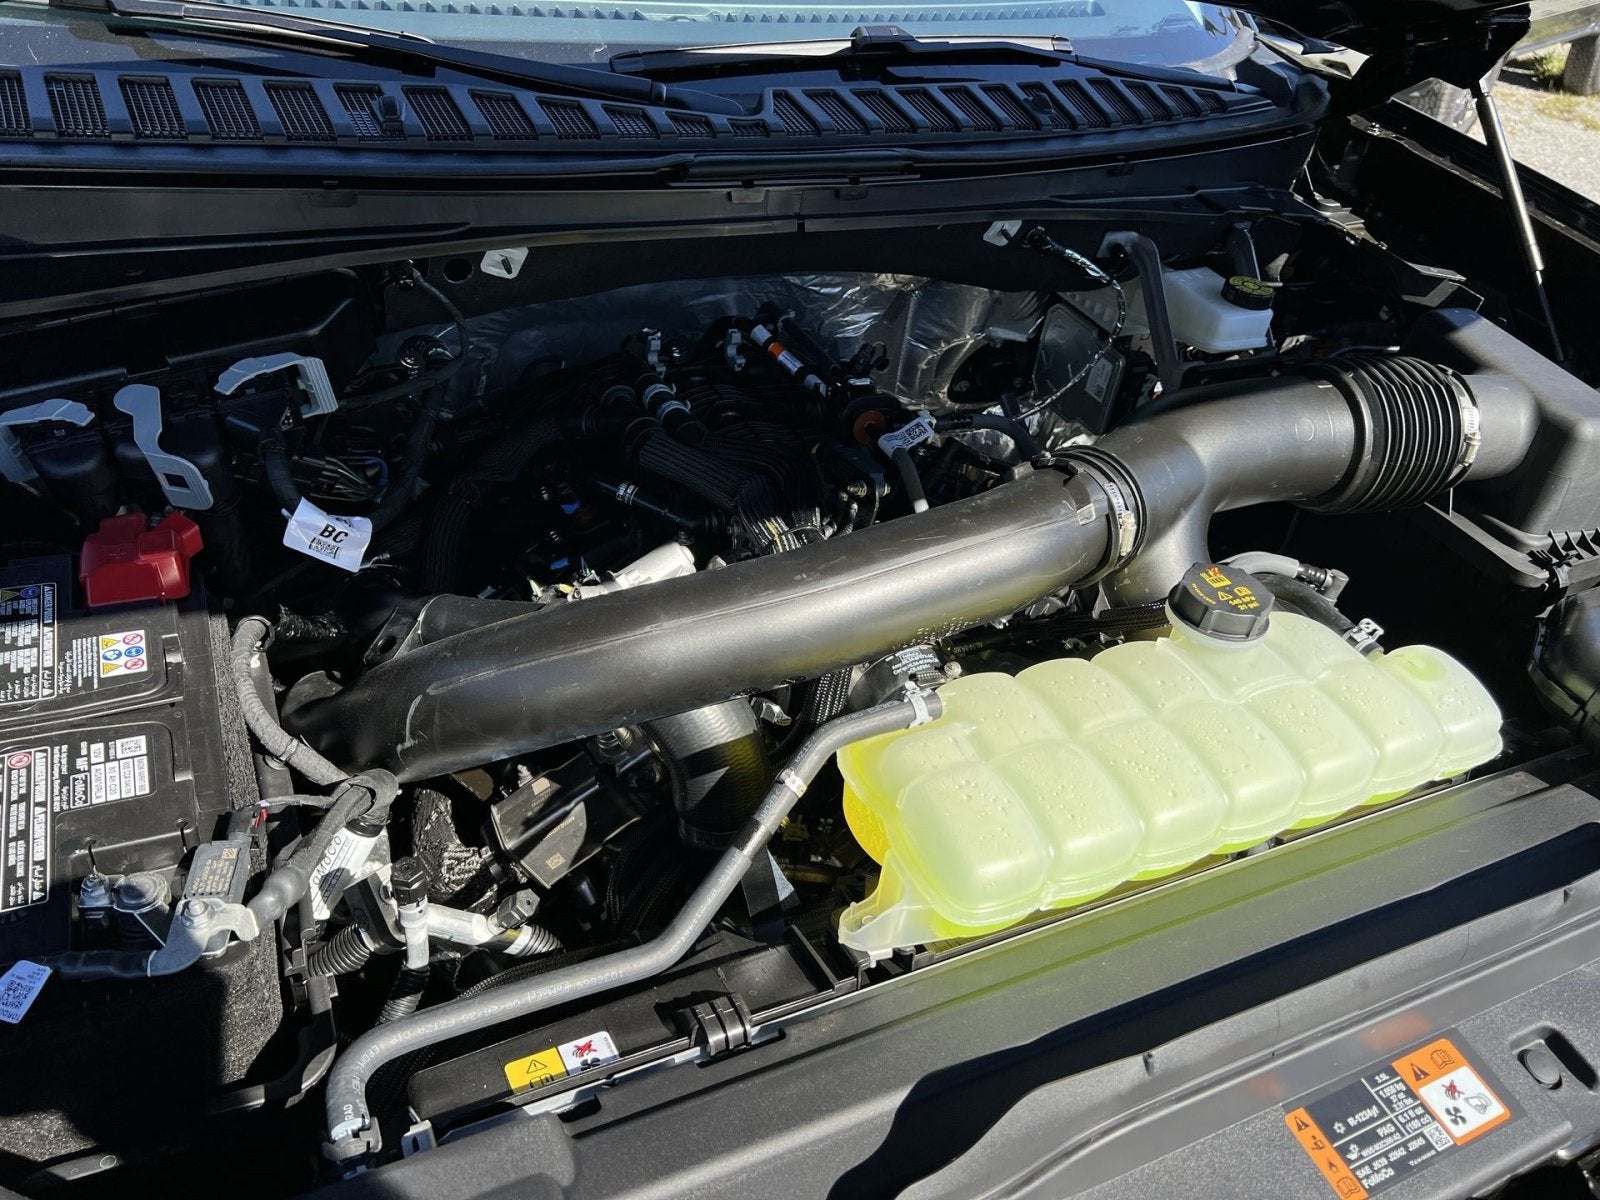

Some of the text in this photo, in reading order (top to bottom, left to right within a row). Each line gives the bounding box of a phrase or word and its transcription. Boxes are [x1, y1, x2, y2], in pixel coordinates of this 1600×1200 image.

[319, 524, 349, 543] BC
[93, 748, 101, 758] 12V
[76, 757, 88, 771] MF
[110, 775, 117, 783] Ah
[74, 775, 85, 806] FoMoCo
[109, 785, 118, 795] C20
[312, 835, 342, 887] oMoCo
[1374, 1072, 1390, 1084] 3.5L
[344, 1104, 353, 1120] RAD
[1348, 1106, 1379, 1126] R-1234yf
[1376, 1123, 1396, 1138] PAG
[1356, 1165, 1372, 1178] SAE
[1371, 1157, 1389, 1170] J639
[1362, 1167, 1395, 1189] FoMoCo
